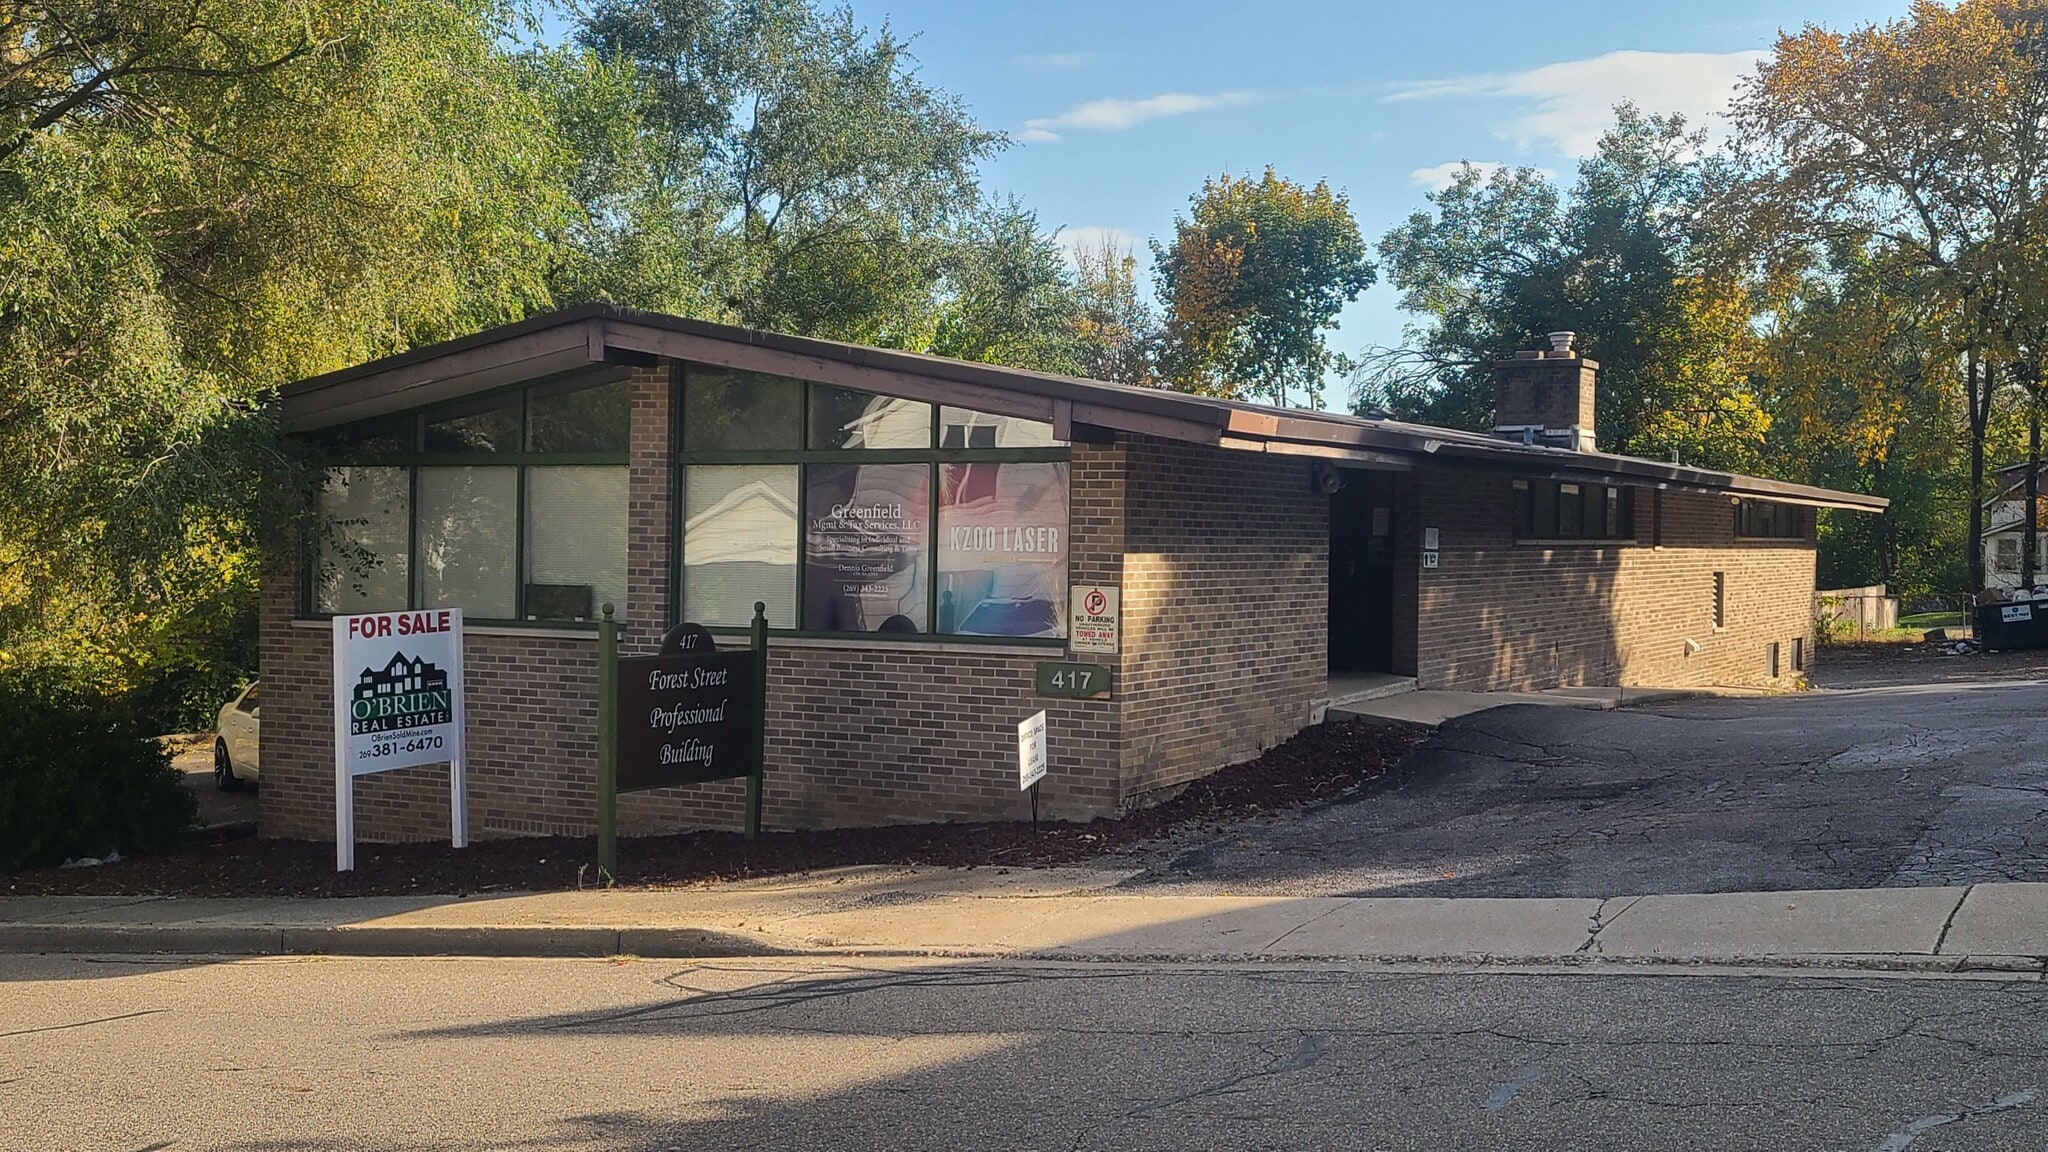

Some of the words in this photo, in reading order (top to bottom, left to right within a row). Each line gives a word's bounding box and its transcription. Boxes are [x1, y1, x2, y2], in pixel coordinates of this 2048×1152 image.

[832, 504, 901, 519] Greenfield
[812, 520, 836, 531] Mgmt
[839, 520, 846, 529] &
[848, 520, 862, 529] Tax
[902, 520, 920, 530] LLC
[950, 526, 996, 552] KZOO
[1003, 527, 1058, 553] LASER
[838, 564, 860, 572] Dennis
[862, 564, 894, 572] Greenfield
[350, 616, 392, 640] FOR
[398, 611, 450, 636] SALE
[1088, 616, 1115, 624] PARKING
[680, 634, 698, 649] 417
[649, 670, 689, 690] Forest
[690, 668, 728, 689] Street
[1052, 670, 1092, 690] 417
[352, 690, 448, 720] O'BRIEN
[650, 698, 728, 734] Professional
[352, 720, 388, 734] REAL
[397, 712, 444, 727] ESTATE
[371, 729, 433, 742] OBrienSoldMine.com
[359, 750, 372, 759] 269
[372, 736, 443, 757] 381-6470
[660, 738, 714, 767] Building
